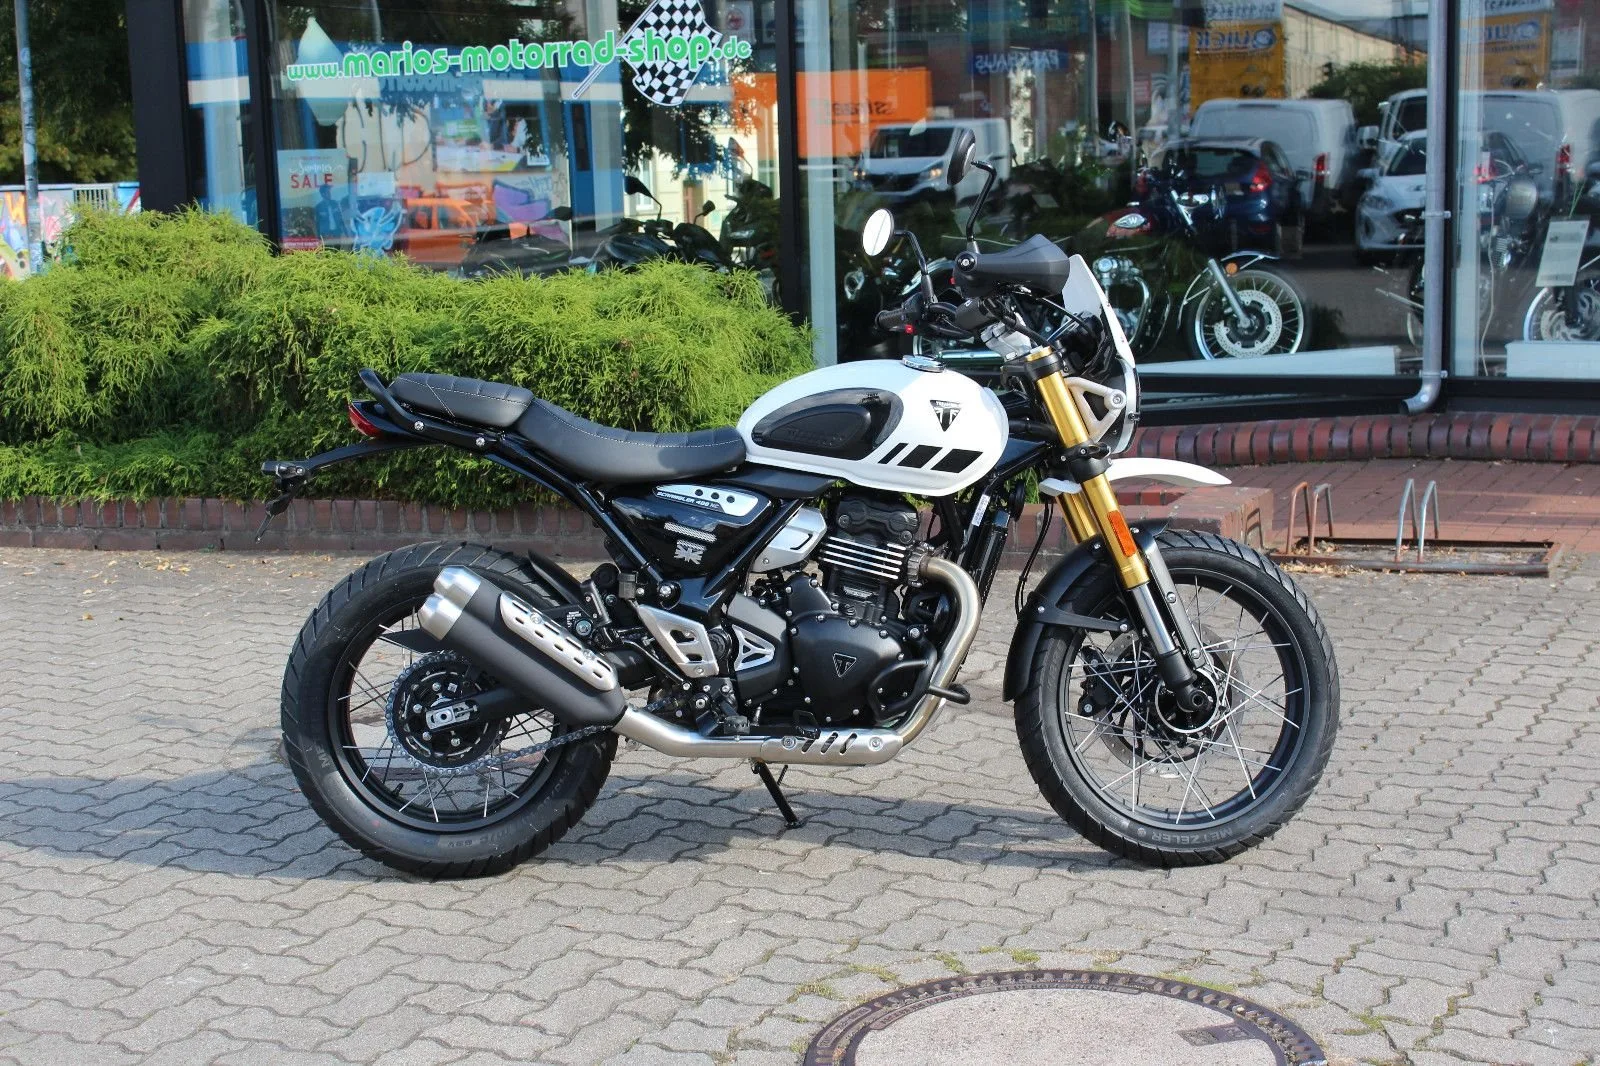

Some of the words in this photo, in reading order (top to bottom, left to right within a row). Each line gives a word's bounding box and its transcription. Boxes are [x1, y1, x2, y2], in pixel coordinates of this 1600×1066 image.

[287, 29, 752, 81] www.marios-motorrad-shop.de
[290, 172, 333, 190] SALE
[656, 491, 695, 504] SCRAMBLER
[1151, 828, 1232, 845] METZELER
